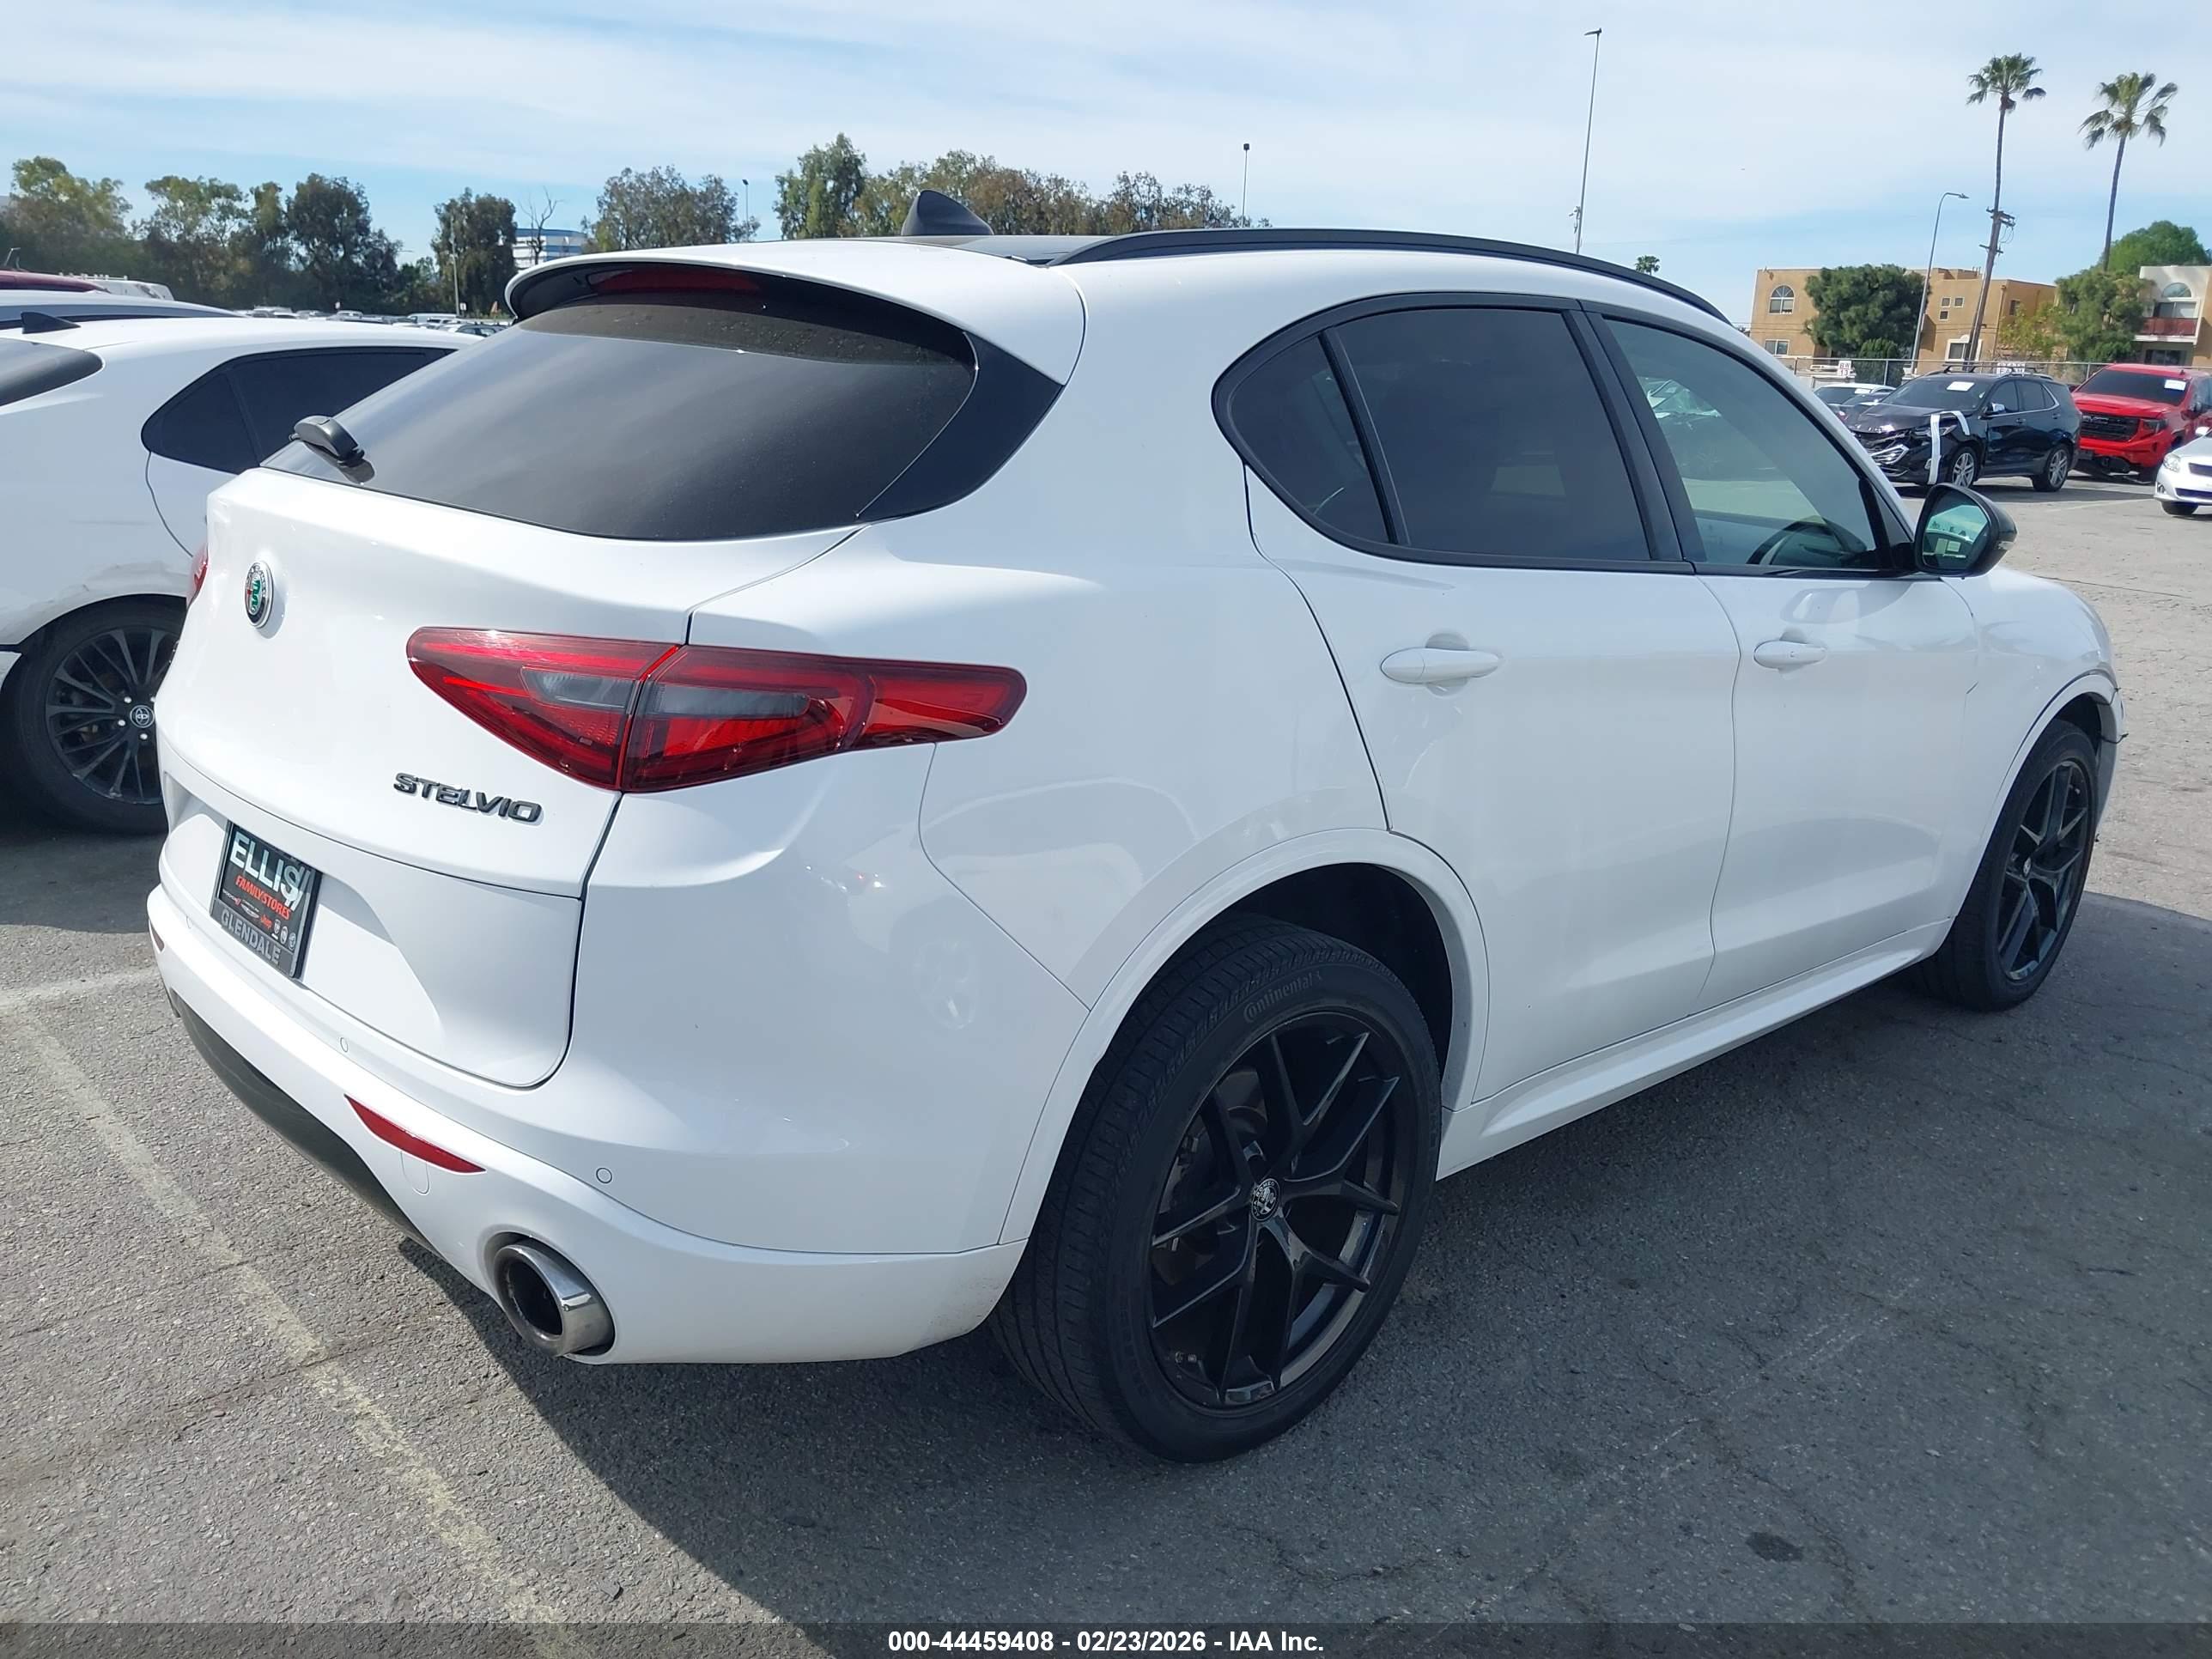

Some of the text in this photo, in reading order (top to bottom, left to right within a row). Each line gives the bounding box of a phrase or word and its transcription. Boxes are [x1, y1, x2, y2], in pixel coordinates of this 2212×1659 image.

[392, 772, 542, 823] STELVIO
[230, 831, 299, 902] ELLIS
[235, 874, 264, 901] FAMILY
[260, 892, 291, 921] STORES
[221, 908, 282, 965] GLENDALE
[1243, 971, 1313, 1024] Continental
